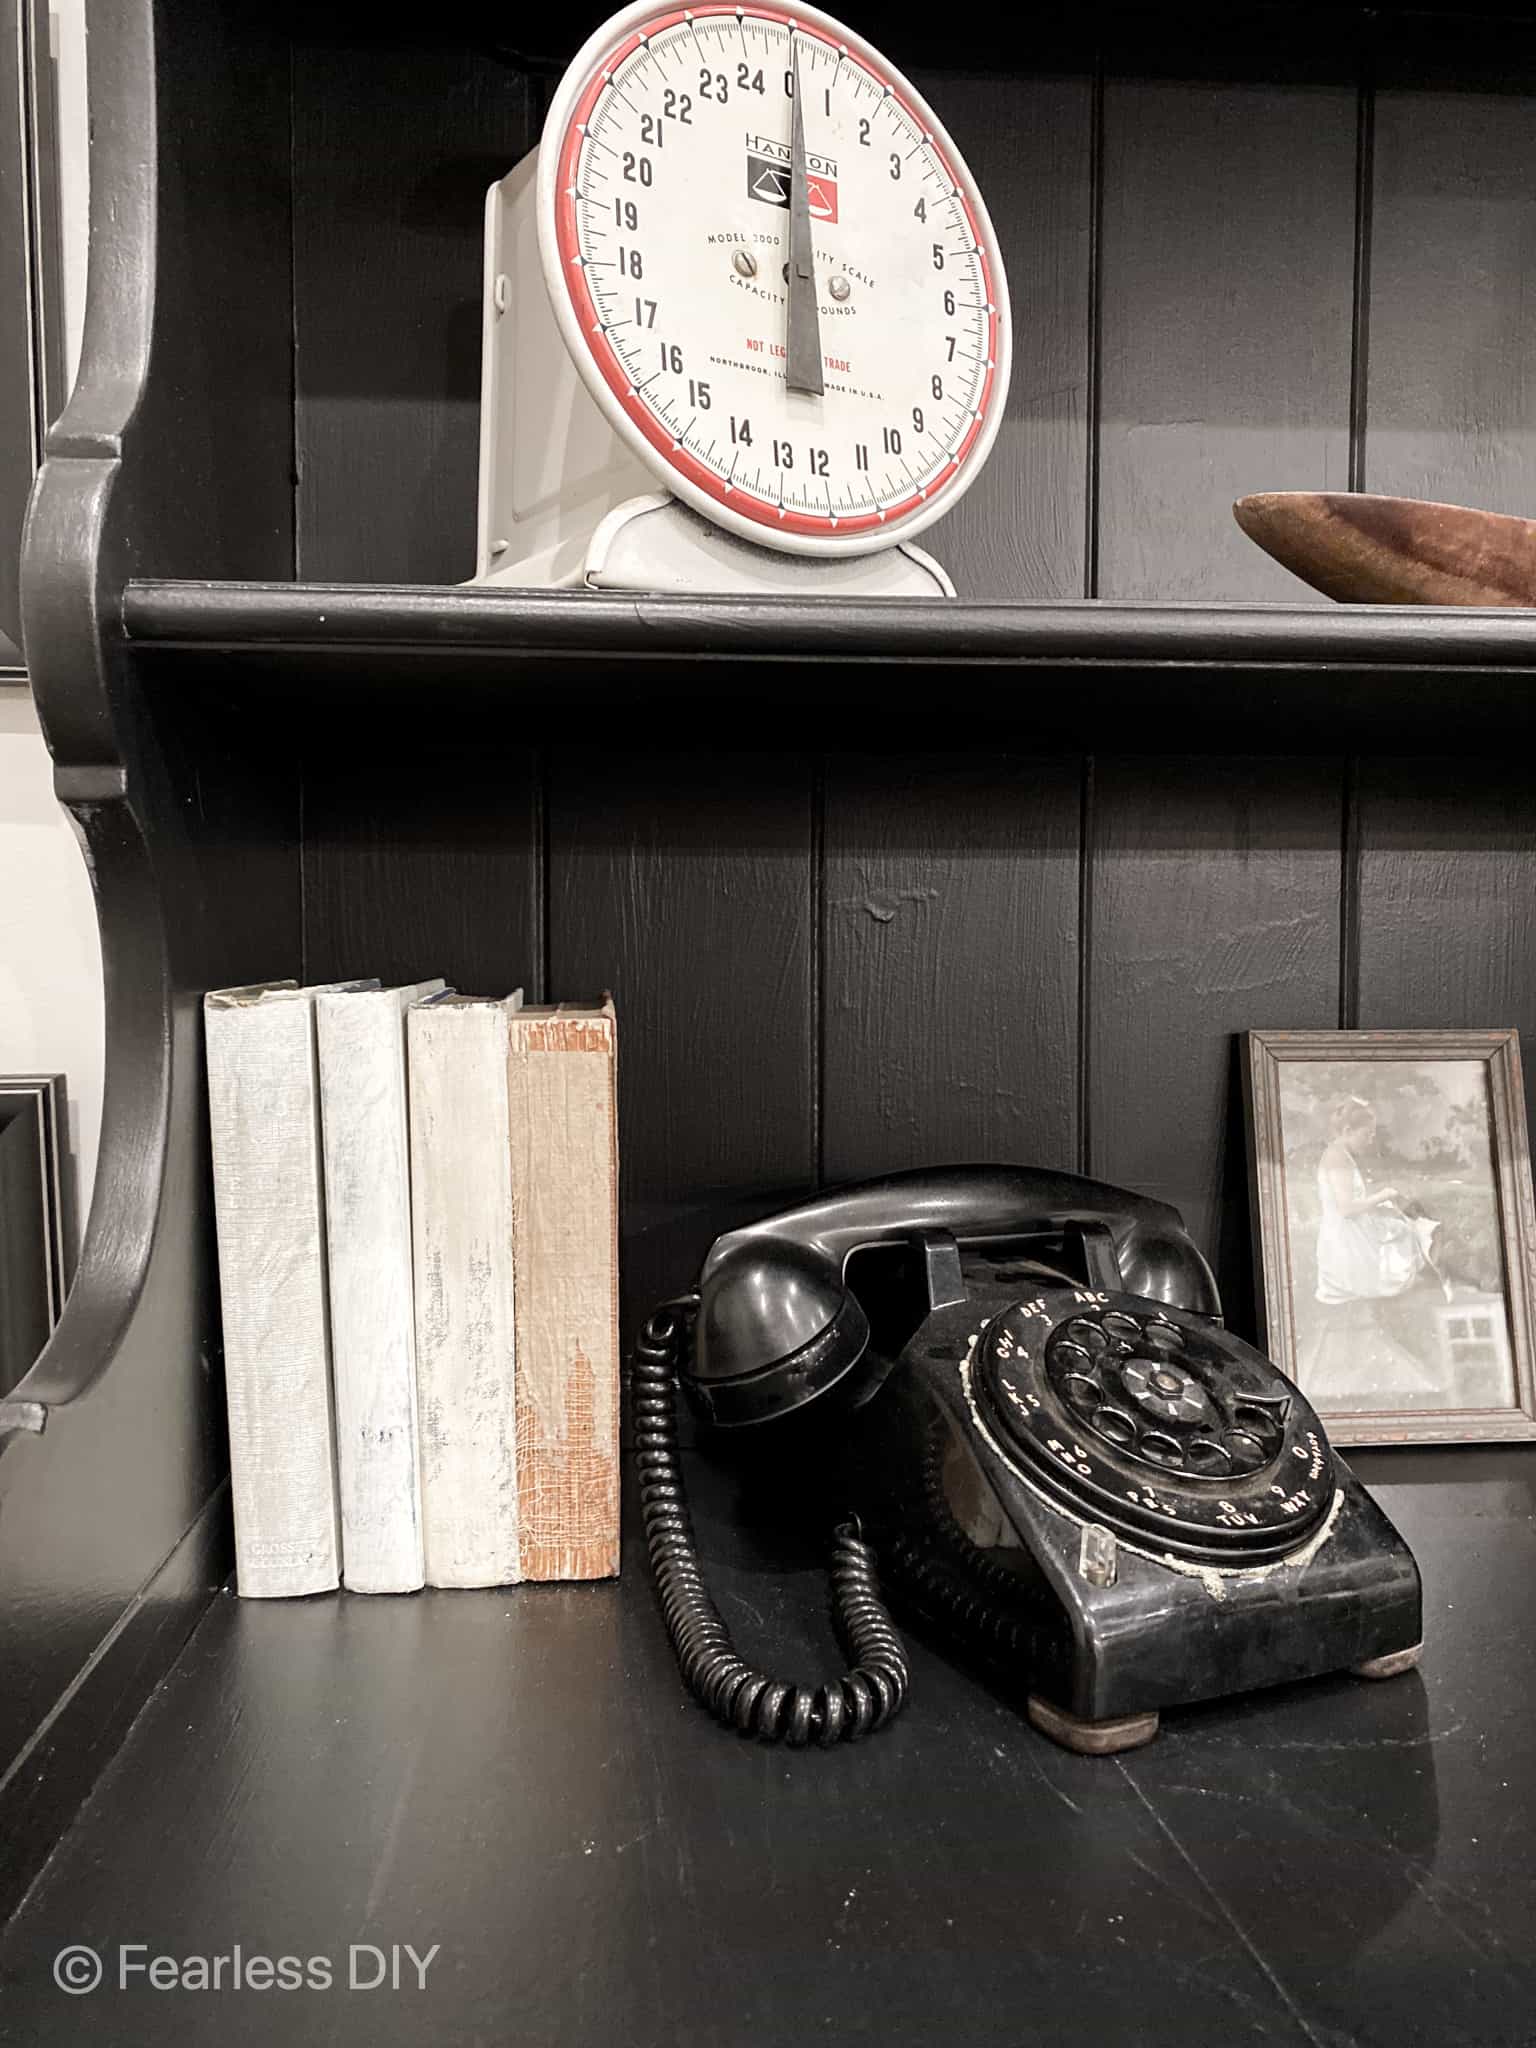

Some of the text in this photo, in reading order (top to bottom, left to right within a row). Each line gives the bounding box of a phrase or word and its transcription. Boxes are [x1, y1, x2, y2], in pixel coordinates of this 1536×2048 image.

[699, 68, 729, 105] 23
[737, 62, 766, 96] 24
[663, 88, 693, 125] 22
[825, 88, 831, 117] 1
[640, 114, 666, 148] 21
[859, 118, 871, 147] 2
[622, 151, 653, 188] 20
[745, 132, 838, 178] HANON
[889, 153, 901, 181] 3
[615, 197, 638, 231] 19
[914, 197, 927, 224] 4
[619, 246, 643, 280] 18
[707, 233, 746, 244] MODEL
[842, 263, 875, 289] SCALE
[932, 243, 945, 271] 5
[729, 274, 785, 305] CAPACITY
[943, 289, 956, 317] 6
[635, 297, 658, 329] 17
[659, 342, 684, 376] 16
[746, 338, 764, 353] NOT
[824, 356, 851, 374] TRADE
[945, 335, 956, 363] 7
[688, 379, 711, 410] 15
[931, 374, 943, 401] 8
[729, 415, 753, 448] 14
[912, 407, 924, 434] 9
[773, 439, 794, 469] 13
[883, 427, 902, 455] 10
[809, 447, 830, 478] 12
[855, 443, 869, 472] 11
[1019, 1299, 1047, 1319] DEF
[1073, 1291, 1109, 1304] ABC
[1040, 1314, 1053, 1327] 3
[1026, 1394, 1041, 1407] 5
[1074, 1444, 1087, 1458] 6
[1142, 1486, 1156, 1498] 7
[1271, 1485, 1286, 1498] 9
[1280, 1489, 1311, 1513] WXY
[1216, 1513, 1259, 1526] TUV
